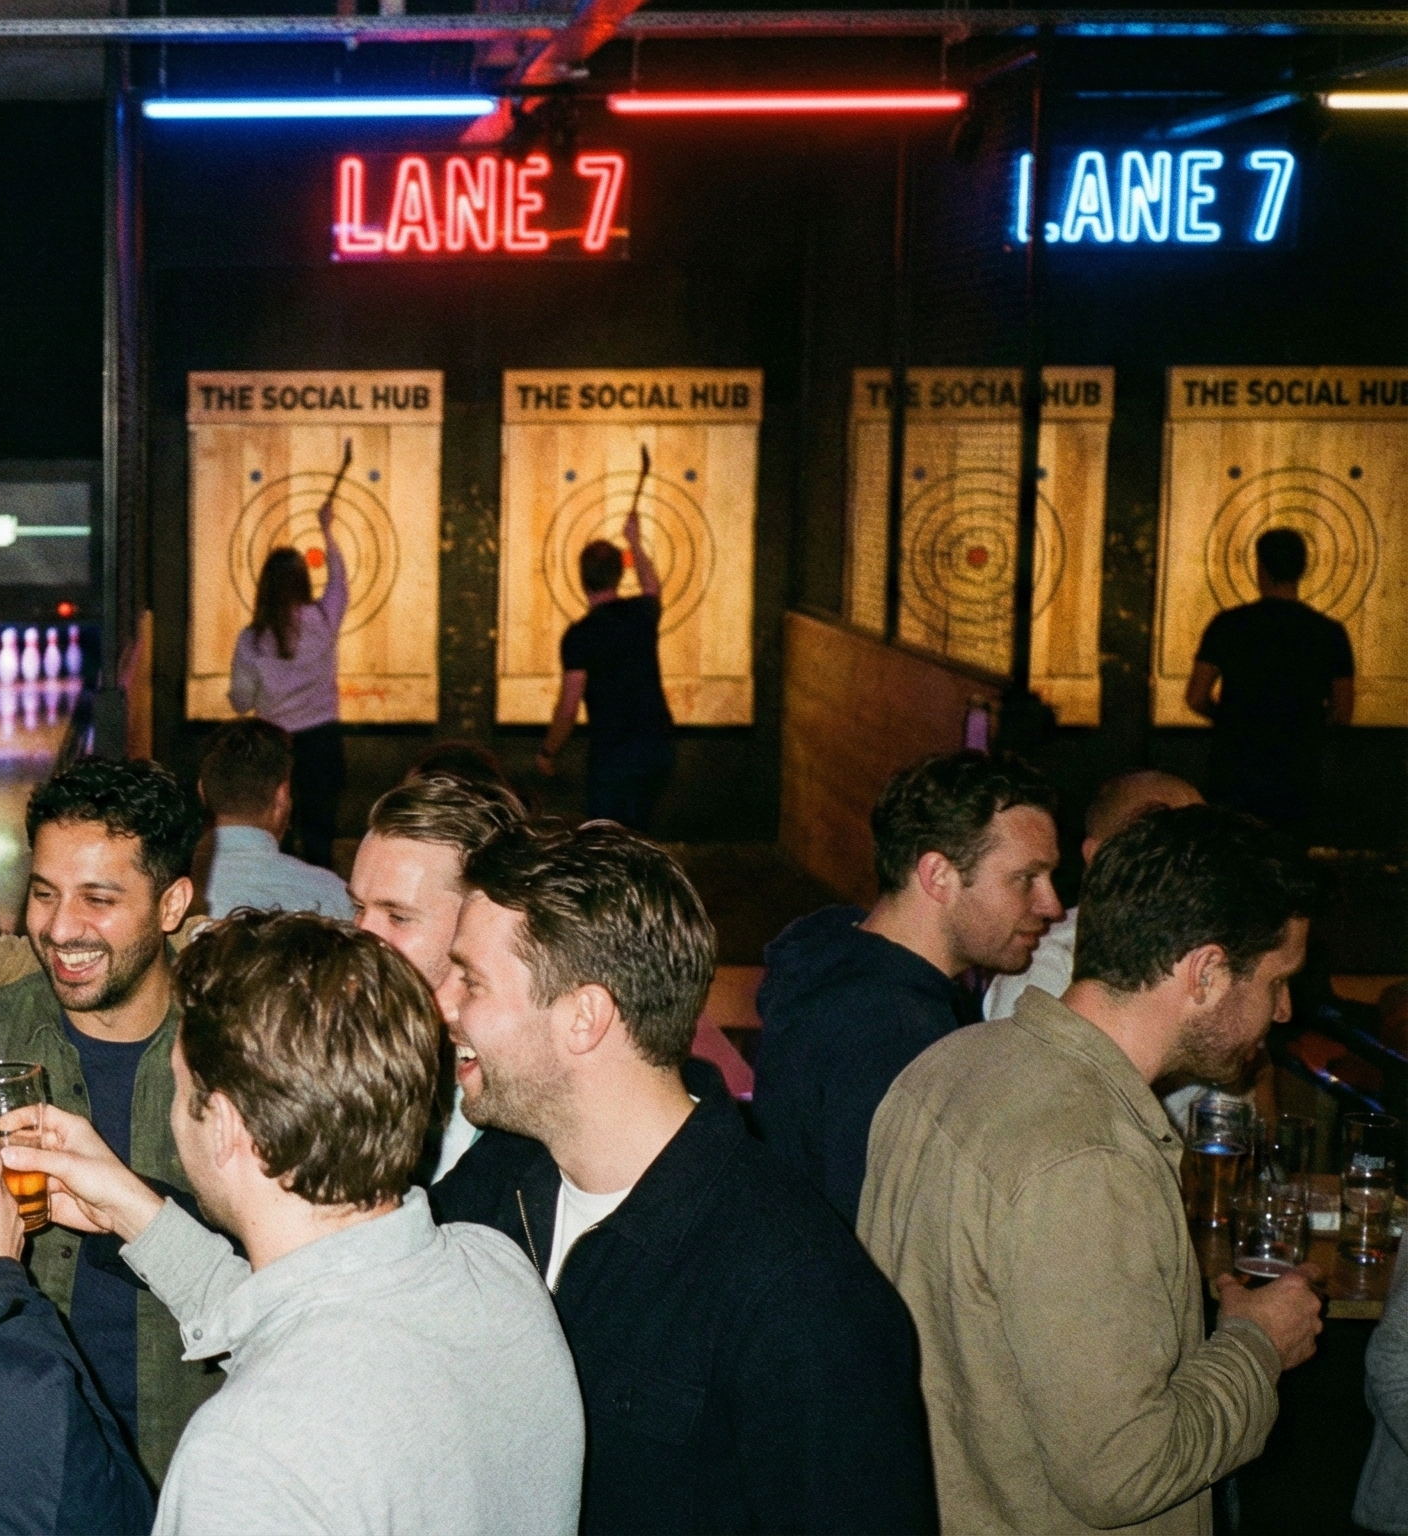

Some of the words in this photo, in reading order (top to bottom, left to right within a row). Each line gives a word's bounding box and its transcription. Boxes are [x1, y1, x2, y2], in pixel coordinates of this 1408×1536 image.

[339, 155, 549, 252] LANE
[575, 154, 625, 252] 7
[1249, 150, 1295, 242] 7
[201, 385, 253, 411] THE
[262, 385, 363, 411] SOCIAL
[372, 384, 431, 411] HUB
[517, 384, 572, 410] THE
[579, 383, 681, 410] SOCIAL
[692, 382, 751, 410] HUB
[867, 381, 922, 409] TE
[930, 380, 1022, 408] SOCIA
[1039, 380, 1103, 407] HUB
[1183, 379, 1238, 407] THE
[1246, 379, 1350, 407] SOCIAL
